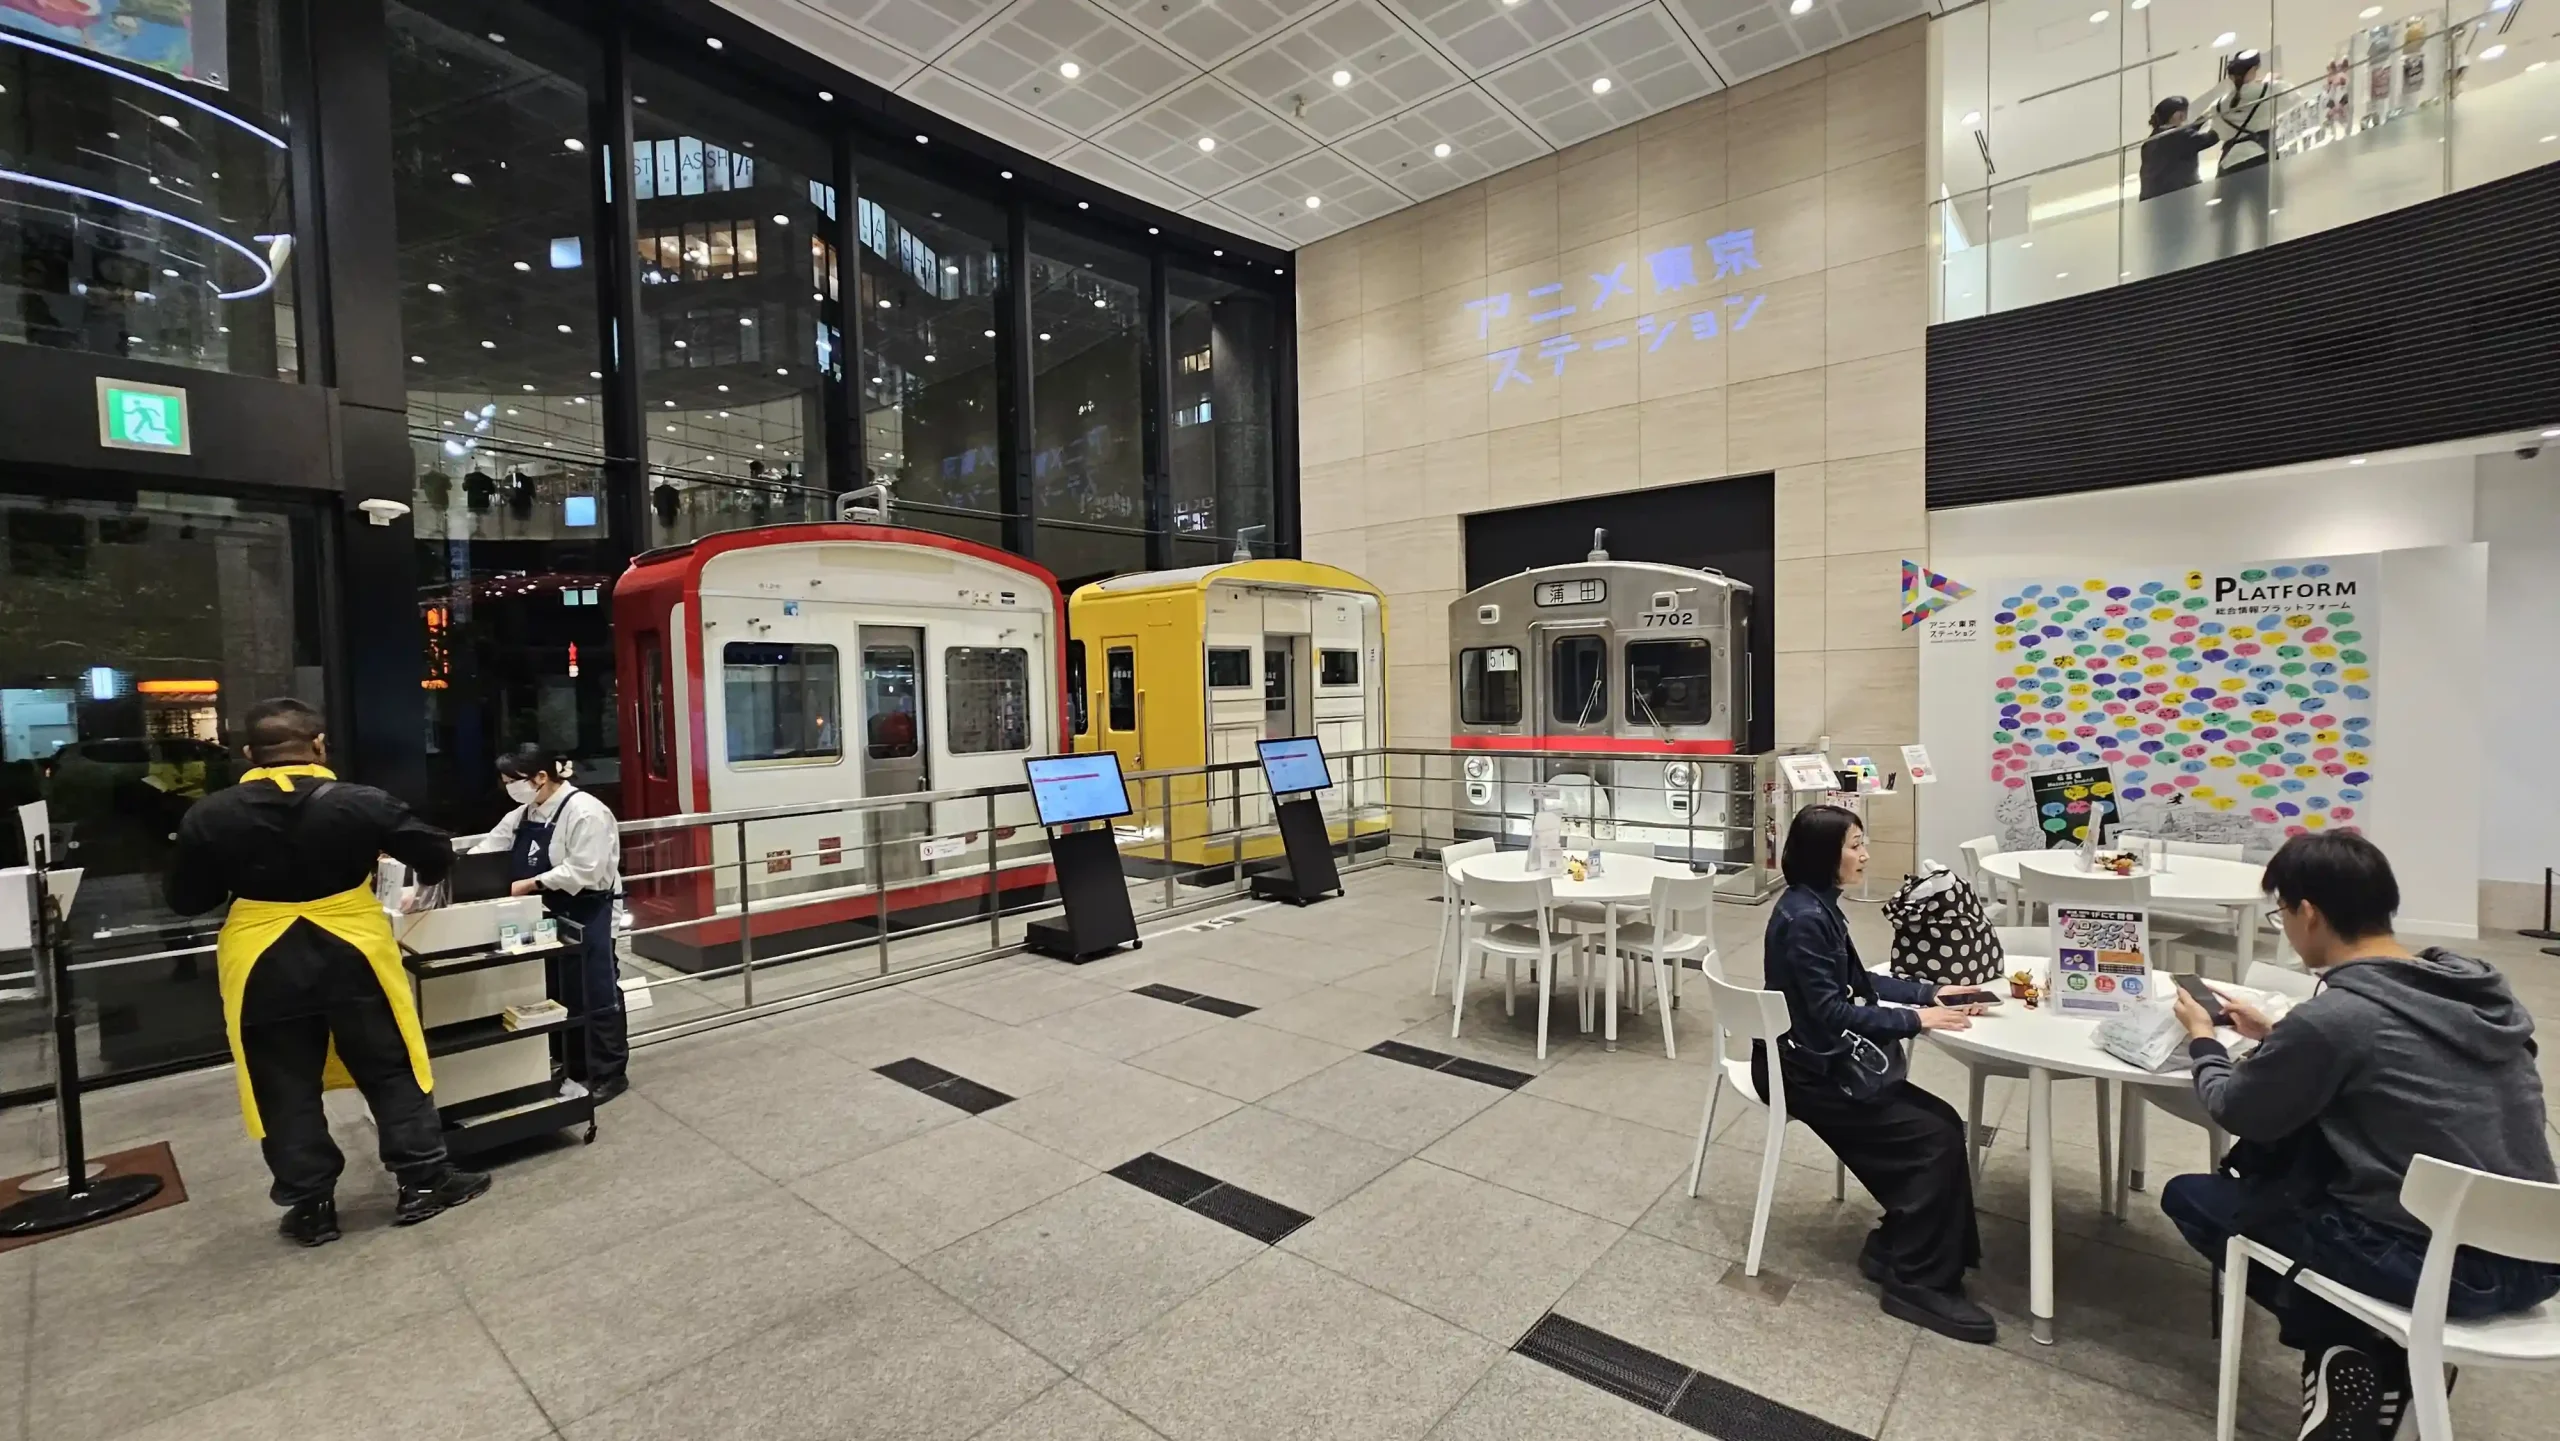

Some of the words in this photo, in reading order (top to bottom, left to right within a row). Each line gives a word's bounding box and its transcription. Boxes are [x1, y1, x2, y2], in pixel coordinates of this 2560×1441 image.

[1464, 228, 1762, 340] アニメ東京
[1487, 294, 1766, 392] ステーション
[1549, 580, 1596, 603] 蒲田
[1643, 612, 1693, 627] 7702
[2215, 601, 2351, 615] 総合情報プラットフォーム
